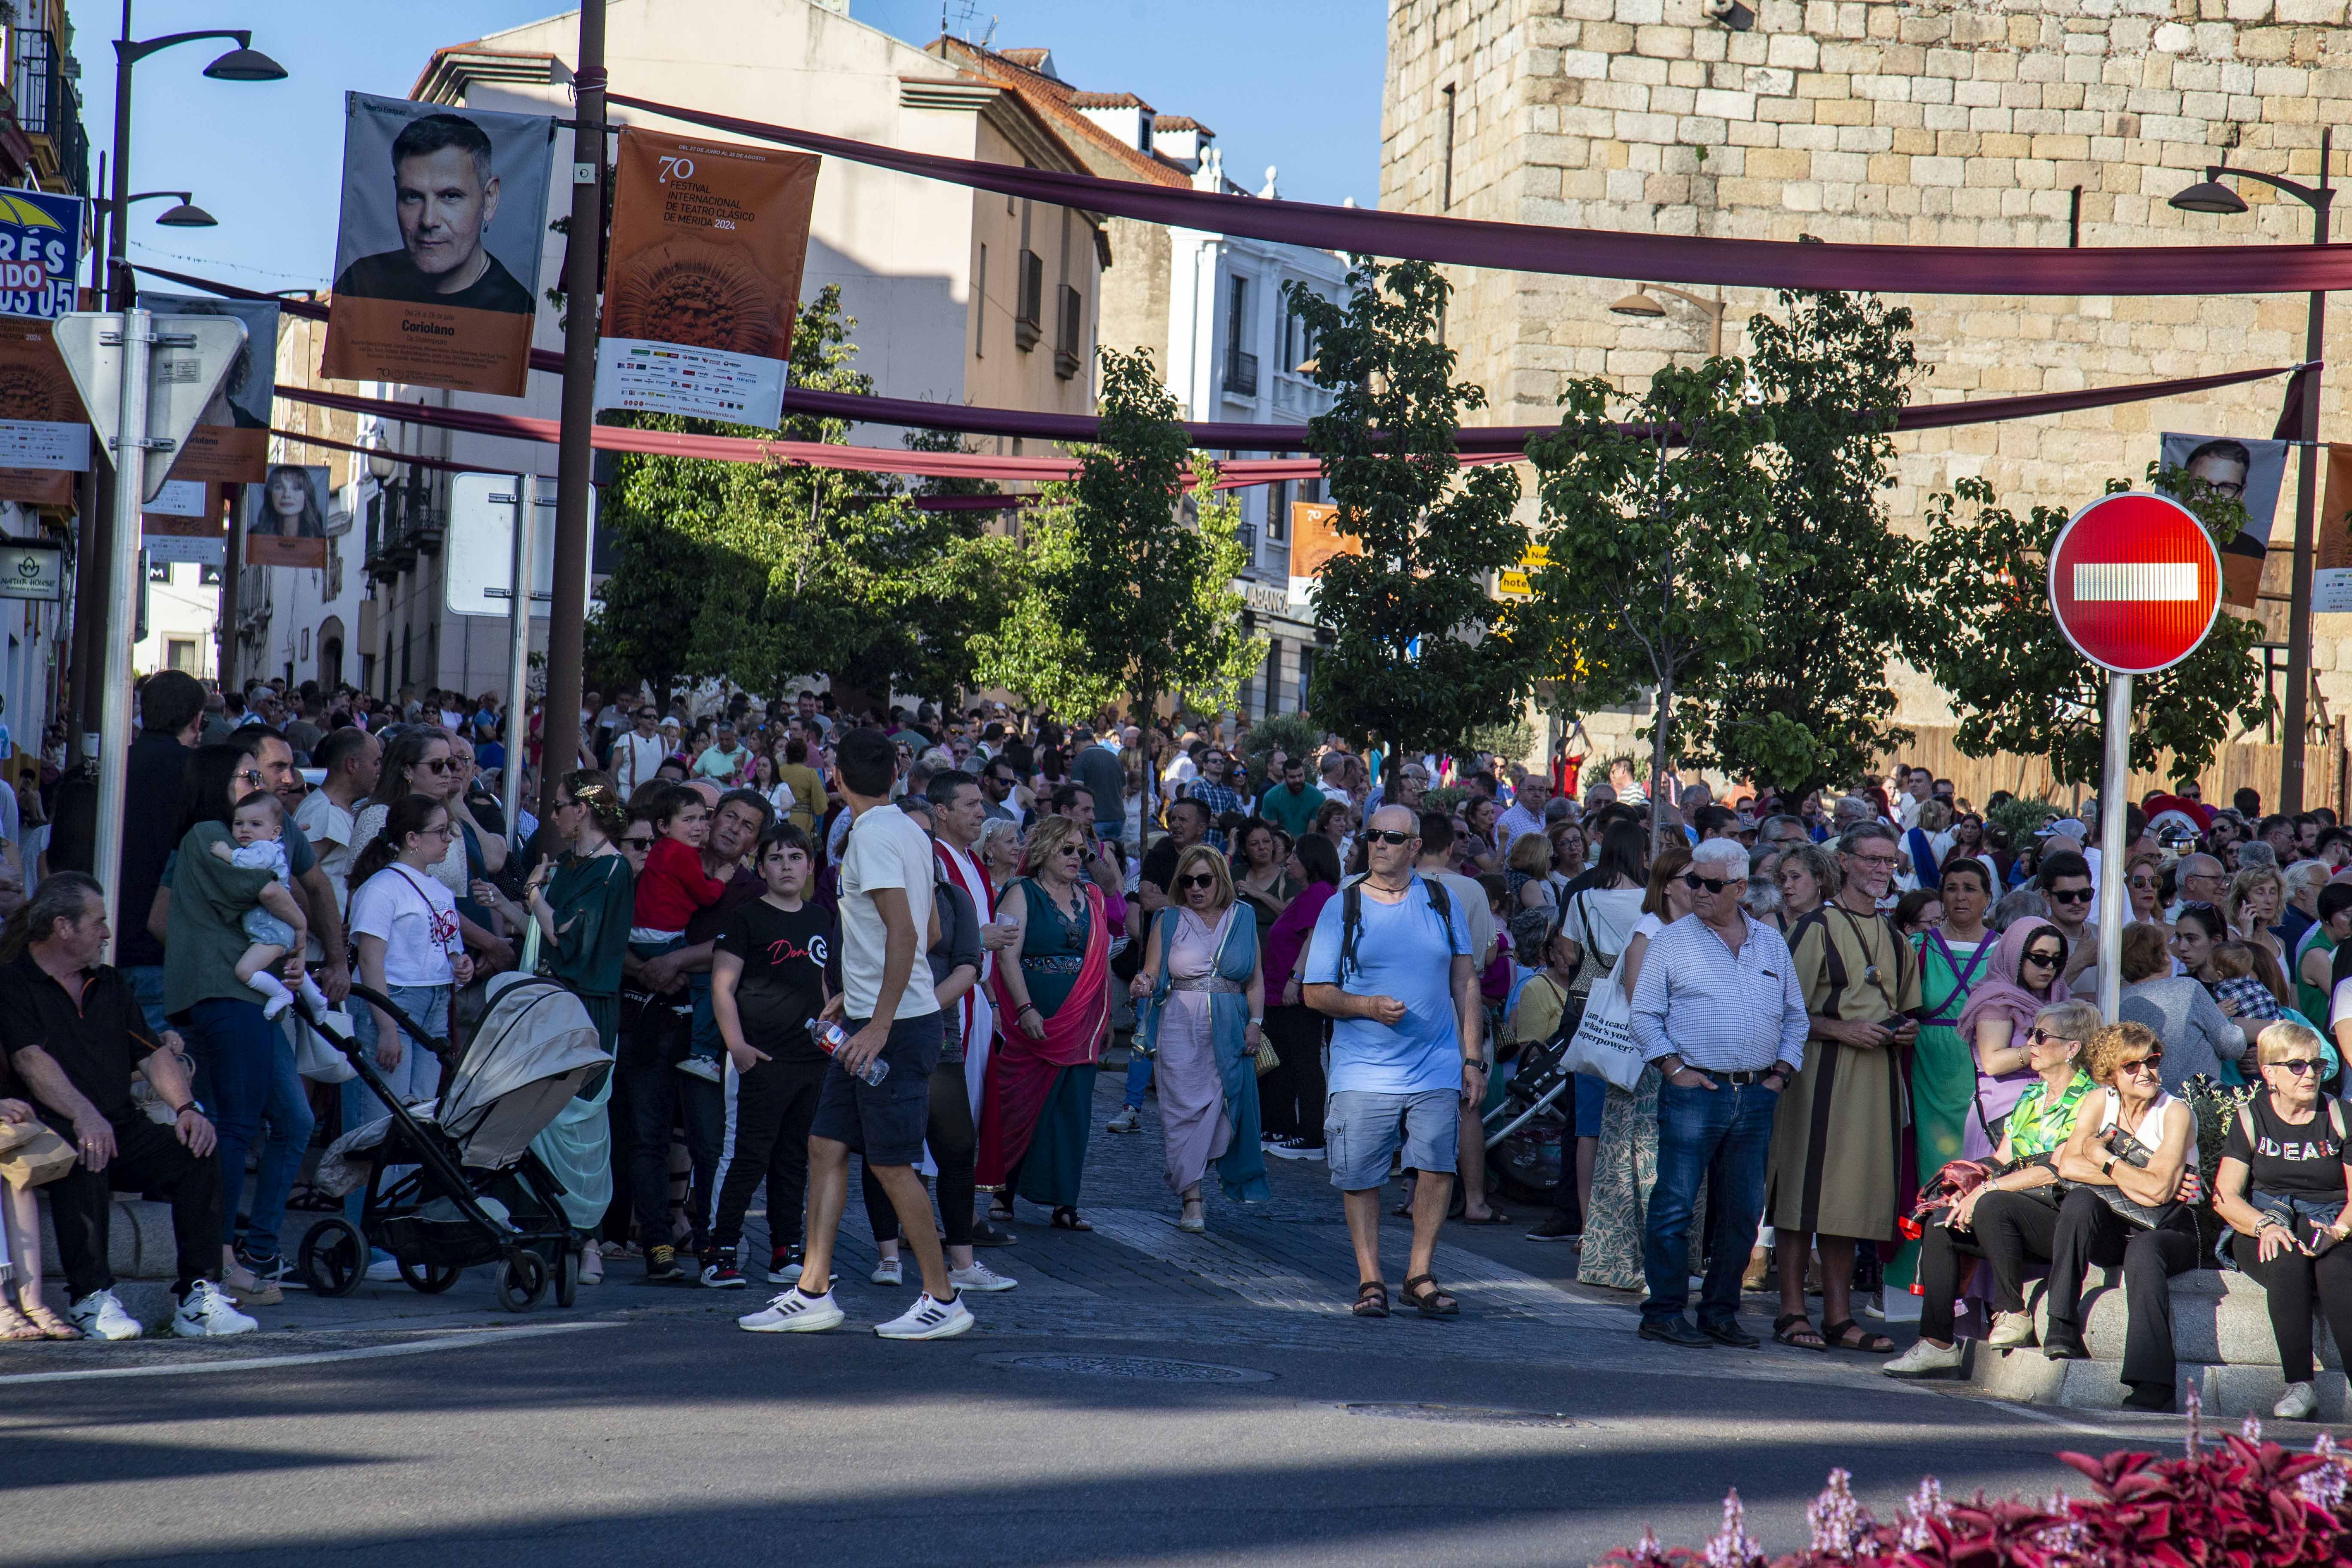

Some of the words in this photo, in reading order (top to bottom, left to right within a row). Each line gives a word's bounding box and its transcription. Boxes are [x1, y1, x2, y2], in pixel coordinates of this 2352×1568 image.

[362, 102, 383, 113] Roberto
[658, 155, 694, 183] 70
[671, 181, 710, 193] FESTIVAL
[668, 192, 741, 208] INTERNACIONAL
[665, 201, 679, 211] DE
[680, 202, 714, 217] TEATRO
[716, 207, 755, 222] CLÁSICO
[664, 212, 676, 222] DE
[714, 219, 736, 231] 2024
[402, 319, 455, 336] Coriolano
[678, 406, 736, 420] www.festivaldemerida.es
[1306, 509, 1322, 522] 70
[1504, 578, 1530, 588] hote
[1584, 1021, 1609, 1036] what's
[1577, 1029, 1635, 1054] superpower?
[2257, 1136, 2340, 1161] IDEAL
